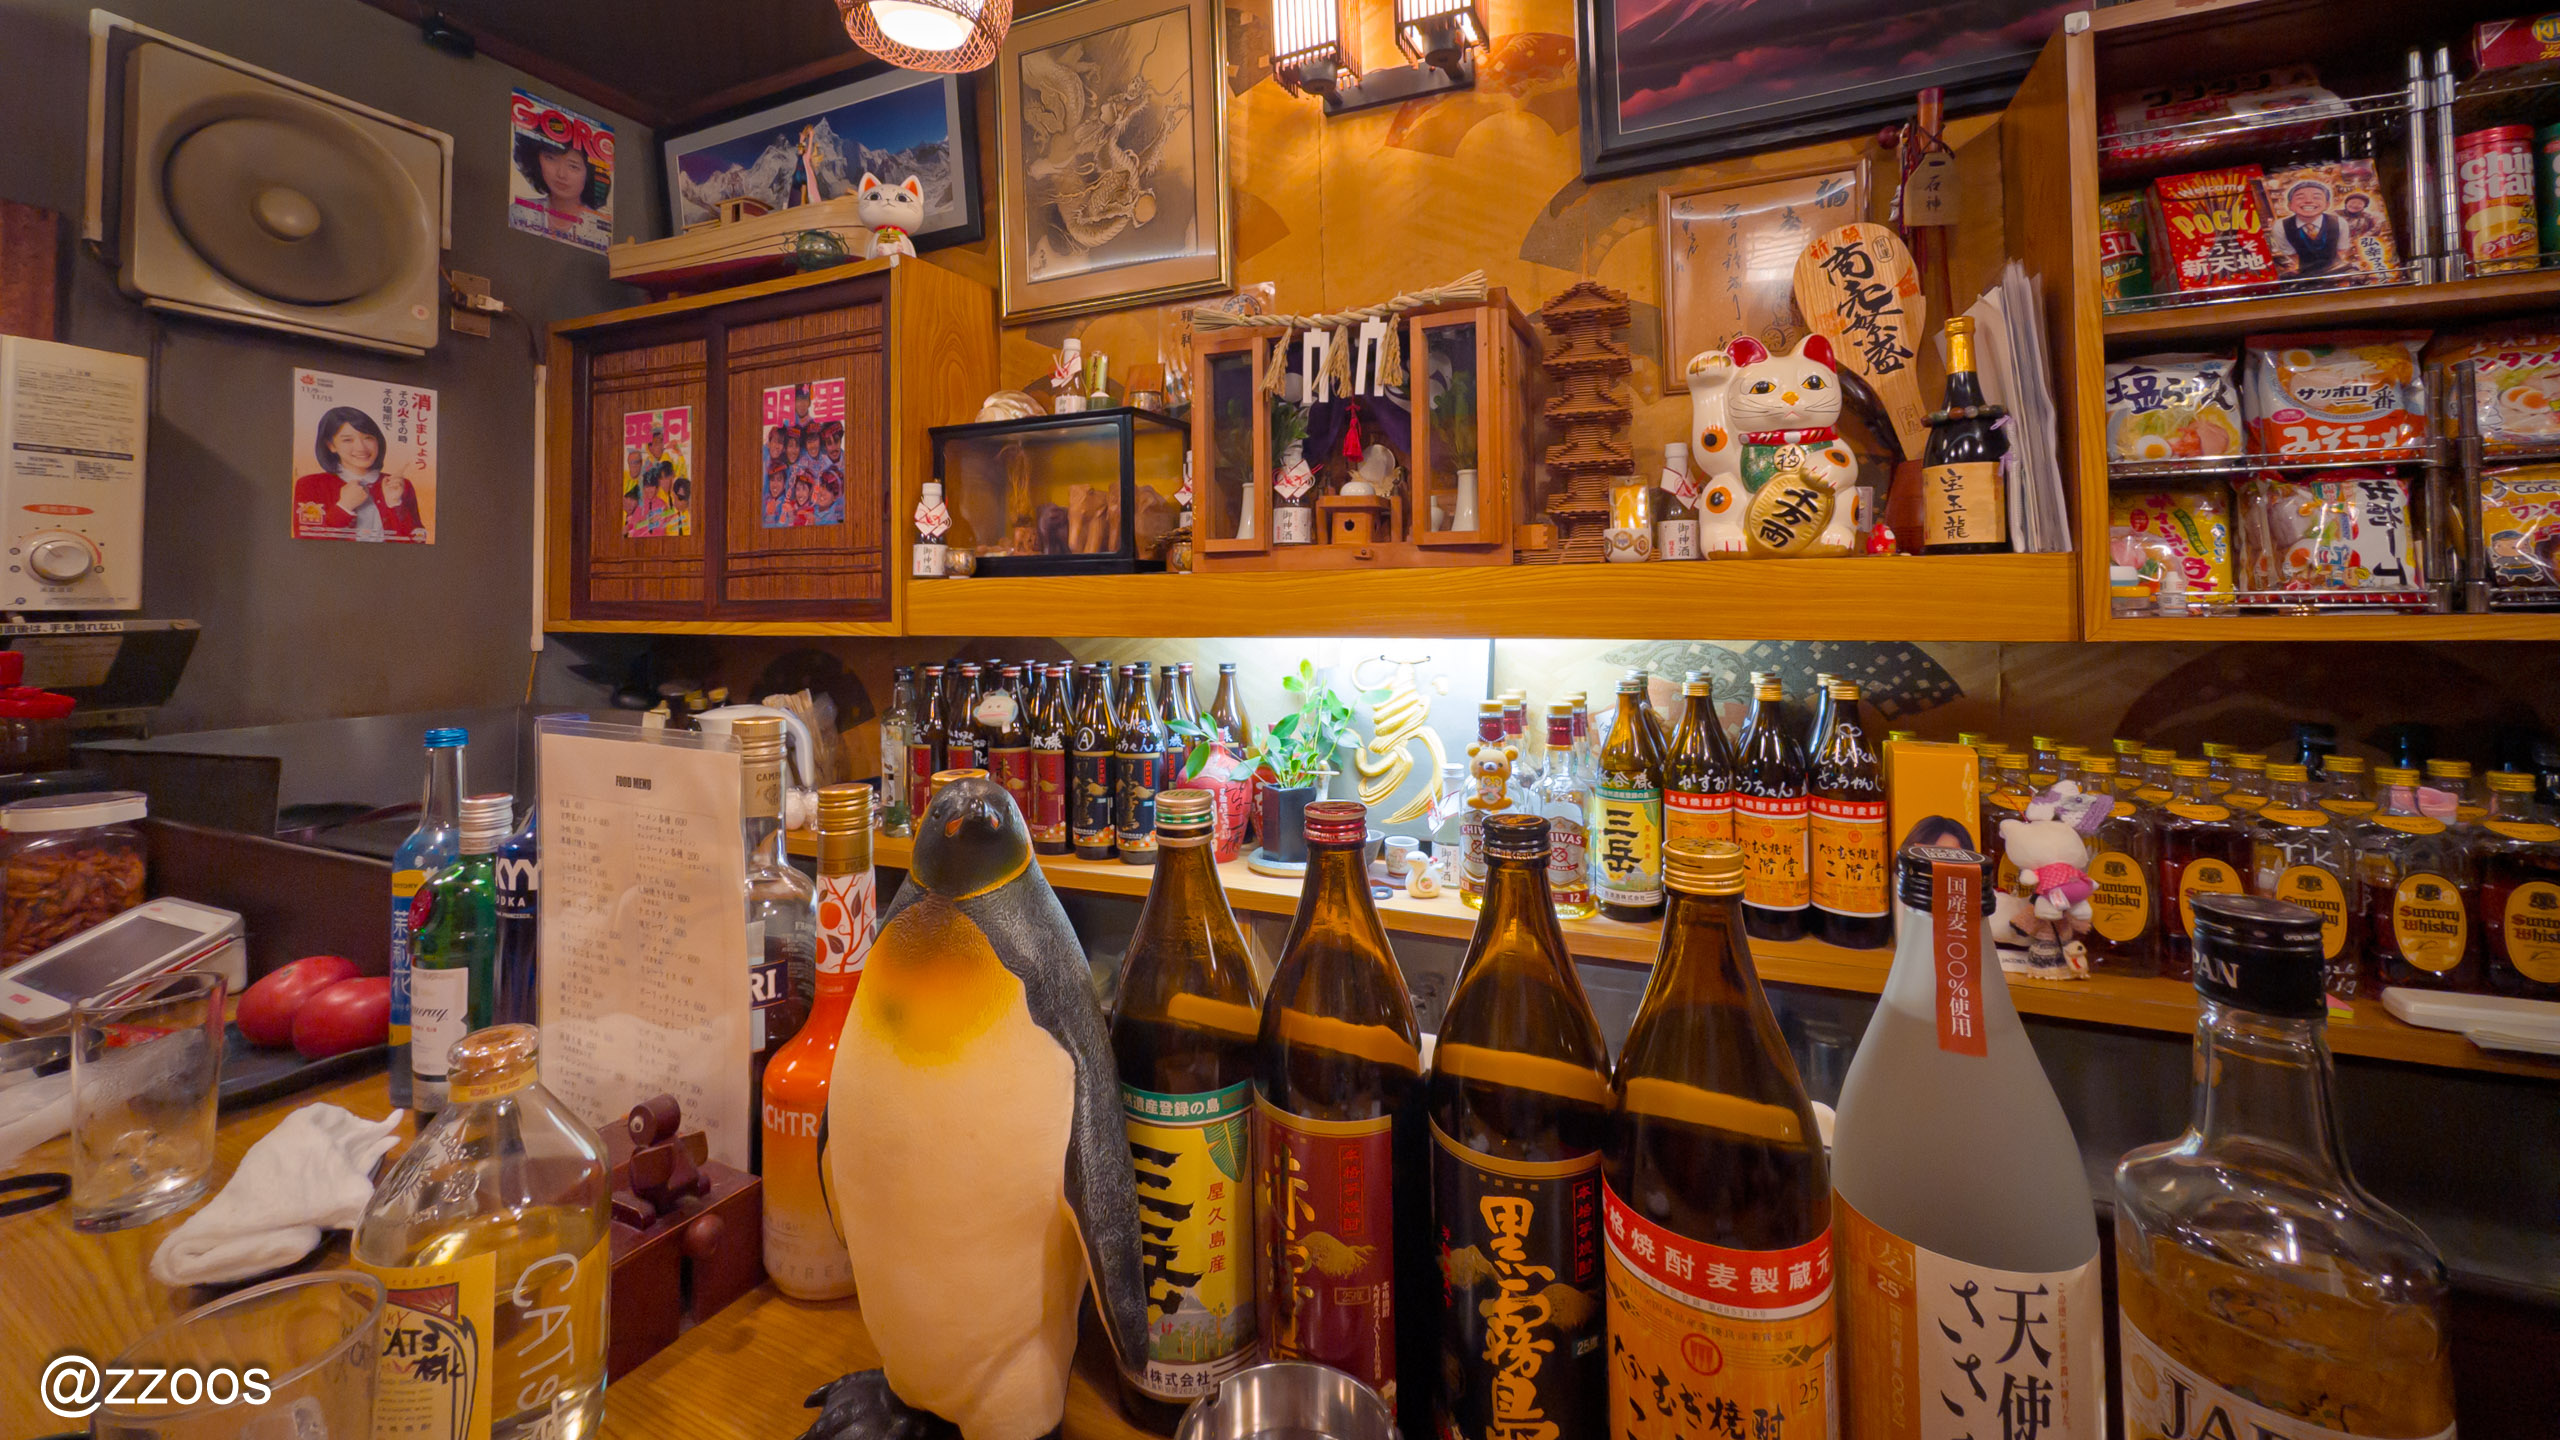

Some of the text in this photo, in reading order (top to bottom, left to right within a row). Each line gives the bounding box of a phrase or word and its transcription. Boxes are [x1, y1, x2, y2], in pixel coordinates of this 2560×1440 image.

[382, 388, 393, 431] その場所で
[397, 390, 410, 444] その火その時
[411, 392, 432, 471] 消しましょう
[1761, 488, 1819, 548] 千万両
[1677, 522, 1690, 557] 御神酒
[0, 622, 123, 634] 直後は、手を触れない
[616, 775, 651, 790] FOOD MENU
[2098, 881, 2141, 897] untory
[2400, 905, 2460, 922] Suntory
[2402, 919, 2459, 937] Whisky
[1207, 1181, 1228, 1275] 屋久島産
[1799, 1378, 1819, 1405] 25
